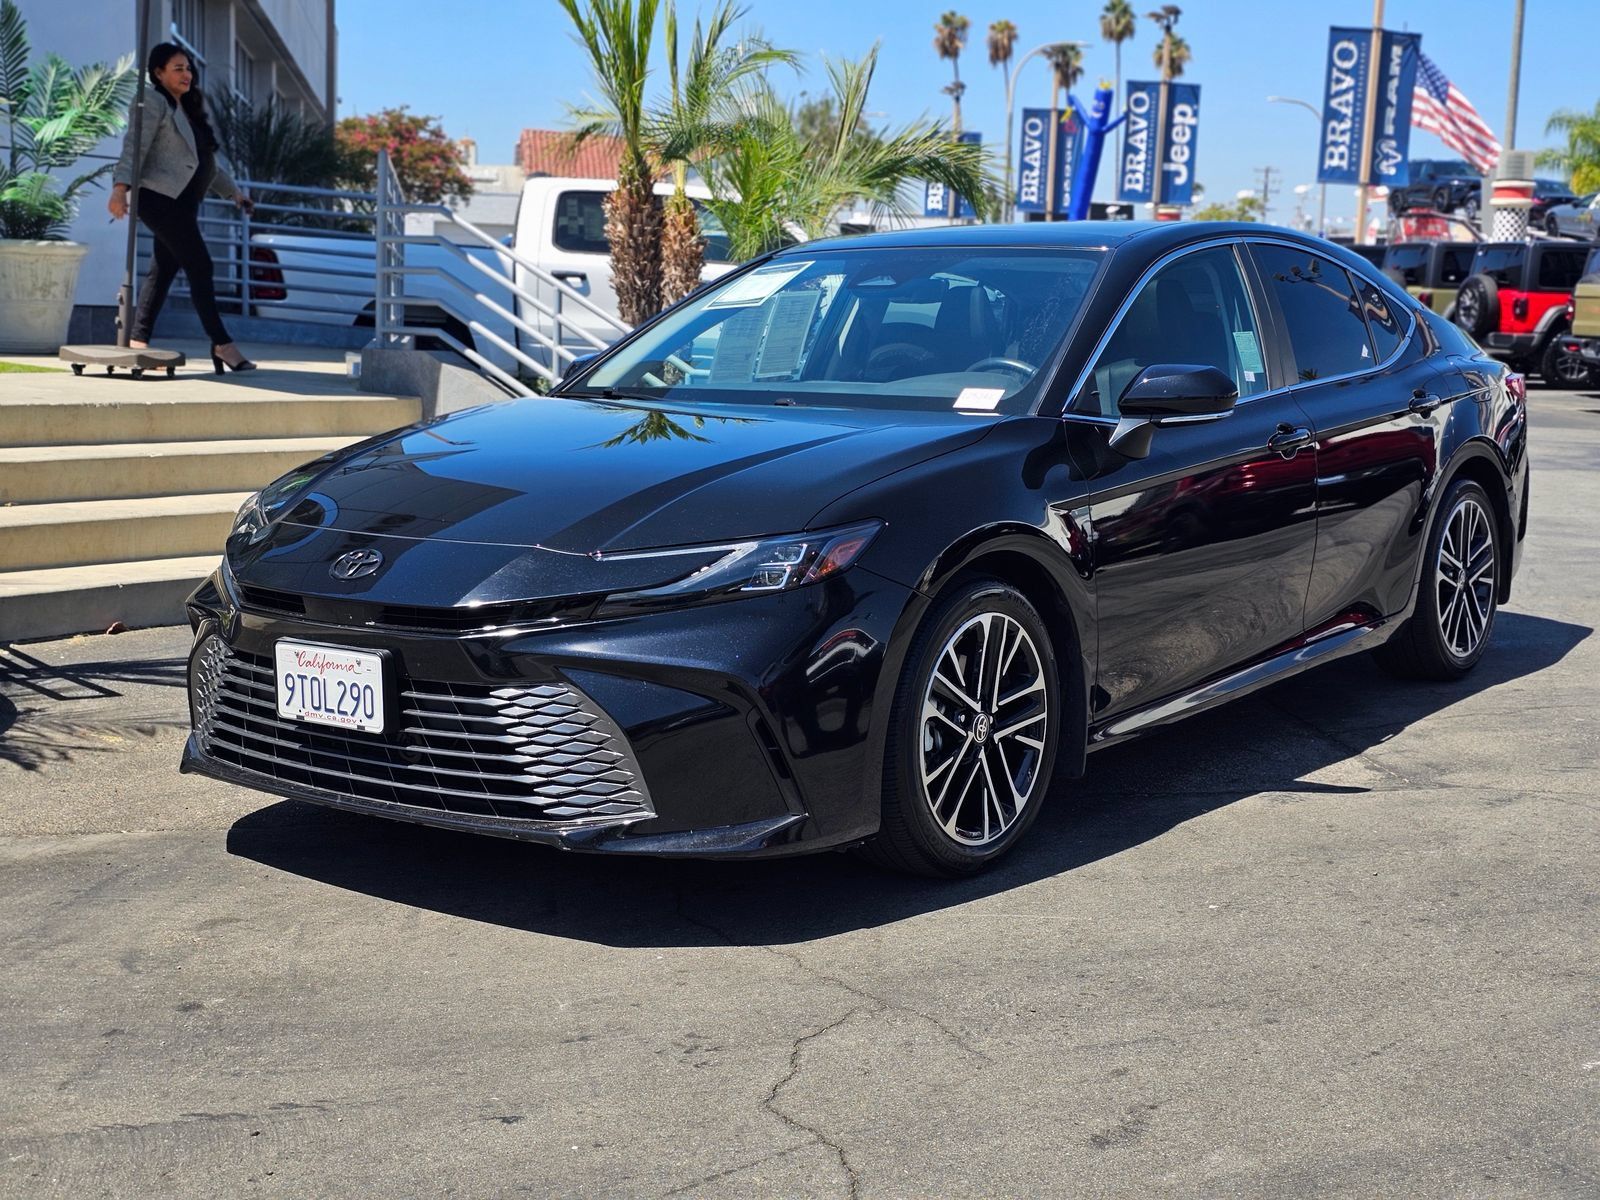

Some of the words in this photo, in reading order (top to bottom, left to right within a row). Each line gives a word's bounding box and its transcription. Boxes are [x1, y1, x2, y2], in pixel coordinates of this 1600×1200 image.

[1324, 40, 1358, 171] BRAVO
[1385, 44, 1404, 136] RAM
[1021, 116, 1043, 204] BRAVO
[1124, 90, 1151, 193] BRAVO
[1162, 103, 1197, 186] Jeep
[284, 672, 375, 720] 9TOL290
[298, 650, 362, 675] California
[304, 711, 357, 724] dmv.ca.gov
